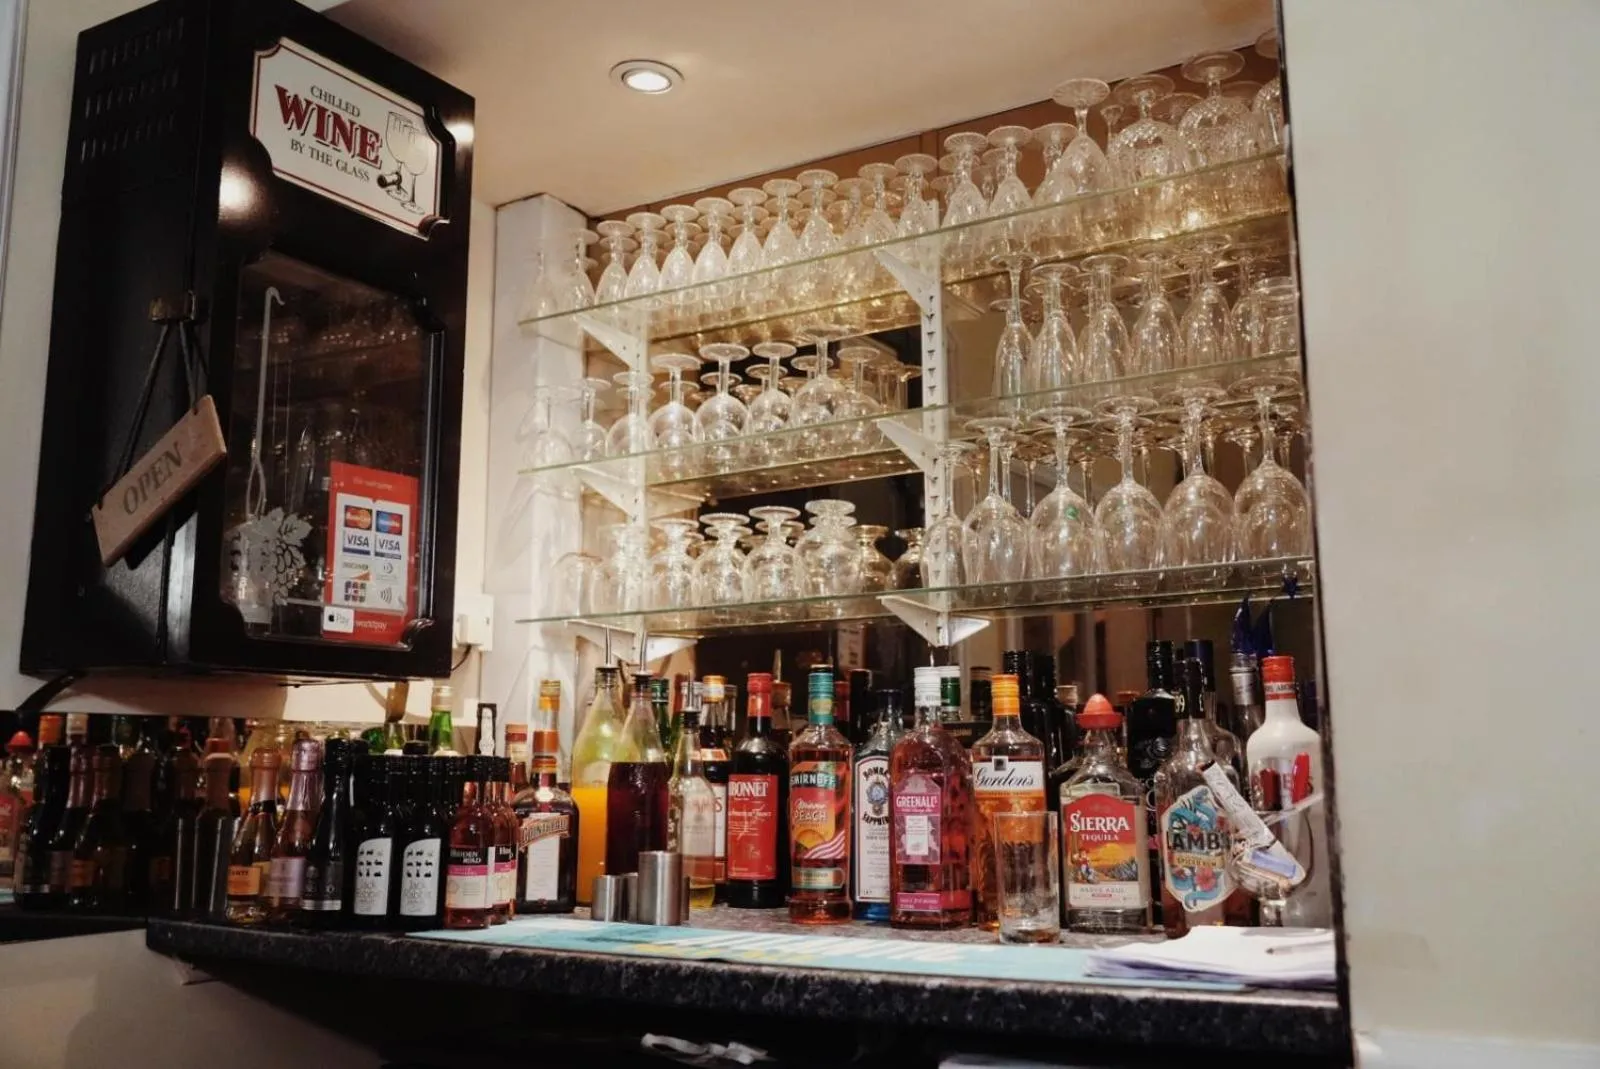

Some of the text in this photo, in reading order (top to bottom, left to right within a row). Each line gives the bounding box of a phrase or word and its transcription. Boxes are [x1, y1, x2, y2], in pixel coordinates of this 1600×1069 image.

[310, 84, 361, 118] CHILLED
[274, 84, 383, 170] WINE
[291, 138, 371, 183] BY THE GLASS
[122, 441, 183, 516] OPEN
[347, 534, 401, 552] VISA VISA
[790, 772, 836, 787] SMIRNOFF
[974, 766, 1034, 787] Gordon's
[728, 781, 768, 797] BONNET
[1070, 809, 1131, 833] SIERRA
[1081, 833, 1120, 842] TEQUILA
